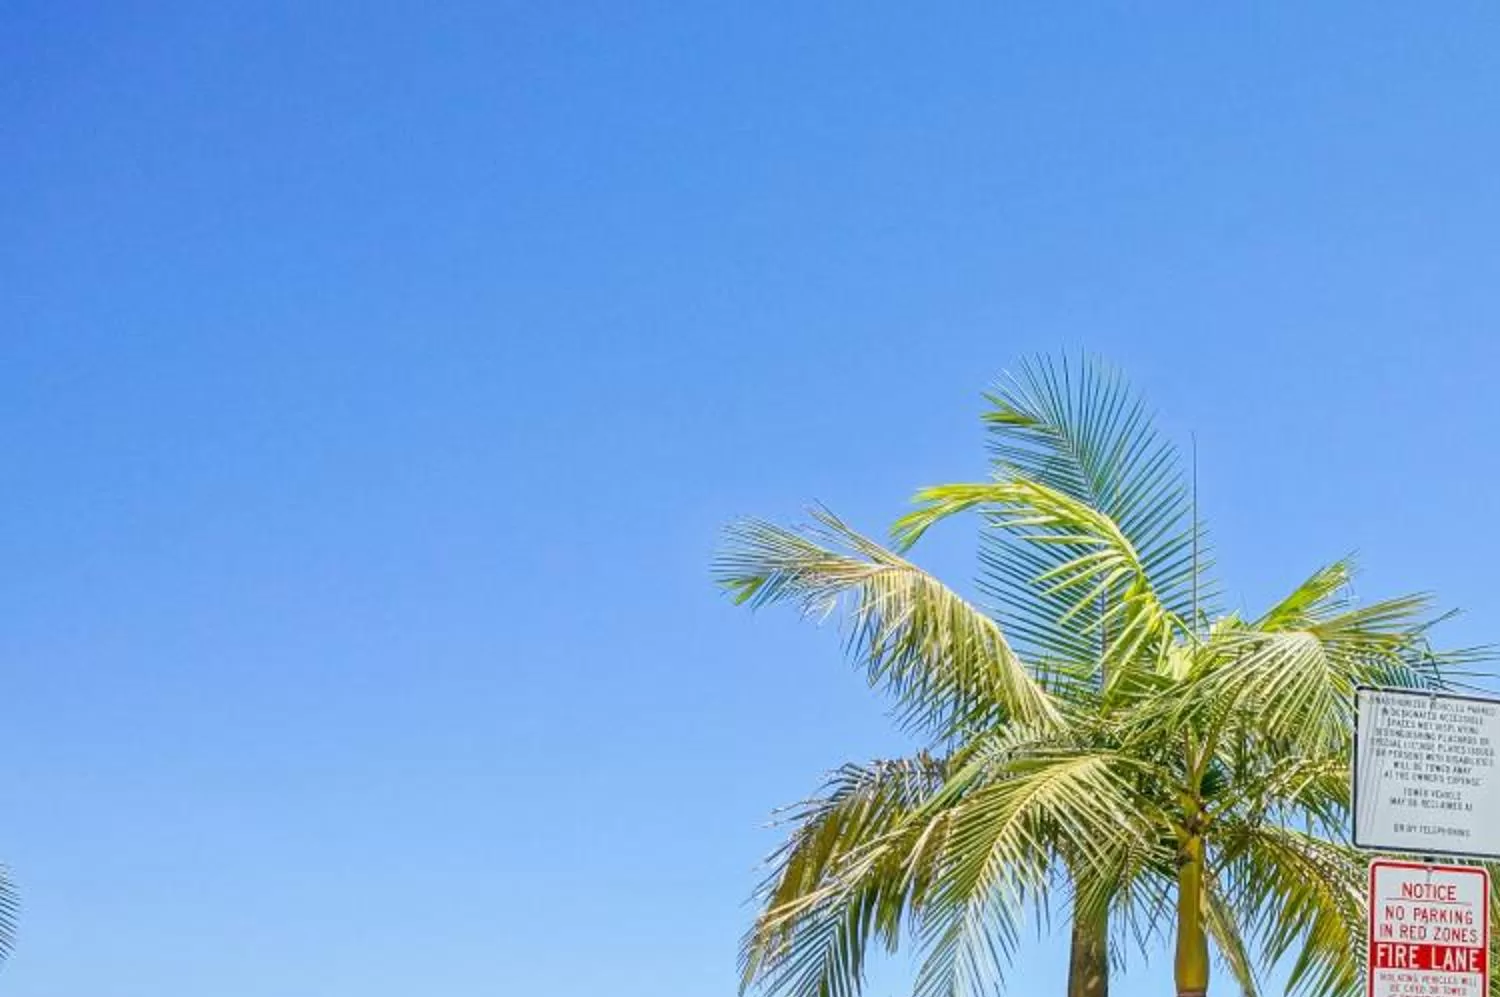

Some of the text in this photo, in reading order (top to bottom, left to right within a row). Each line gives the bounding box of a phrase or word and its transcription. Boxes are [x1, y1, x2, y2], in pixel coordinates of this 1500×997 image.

[1402, 882, 1456, 900] NOTICE
[1385, 906, 1472, 924] NO PARKING
[1380, 924, 1477, 943] IN RED ZONES
[1377, 943, 1480, 971] FIRE LANE
